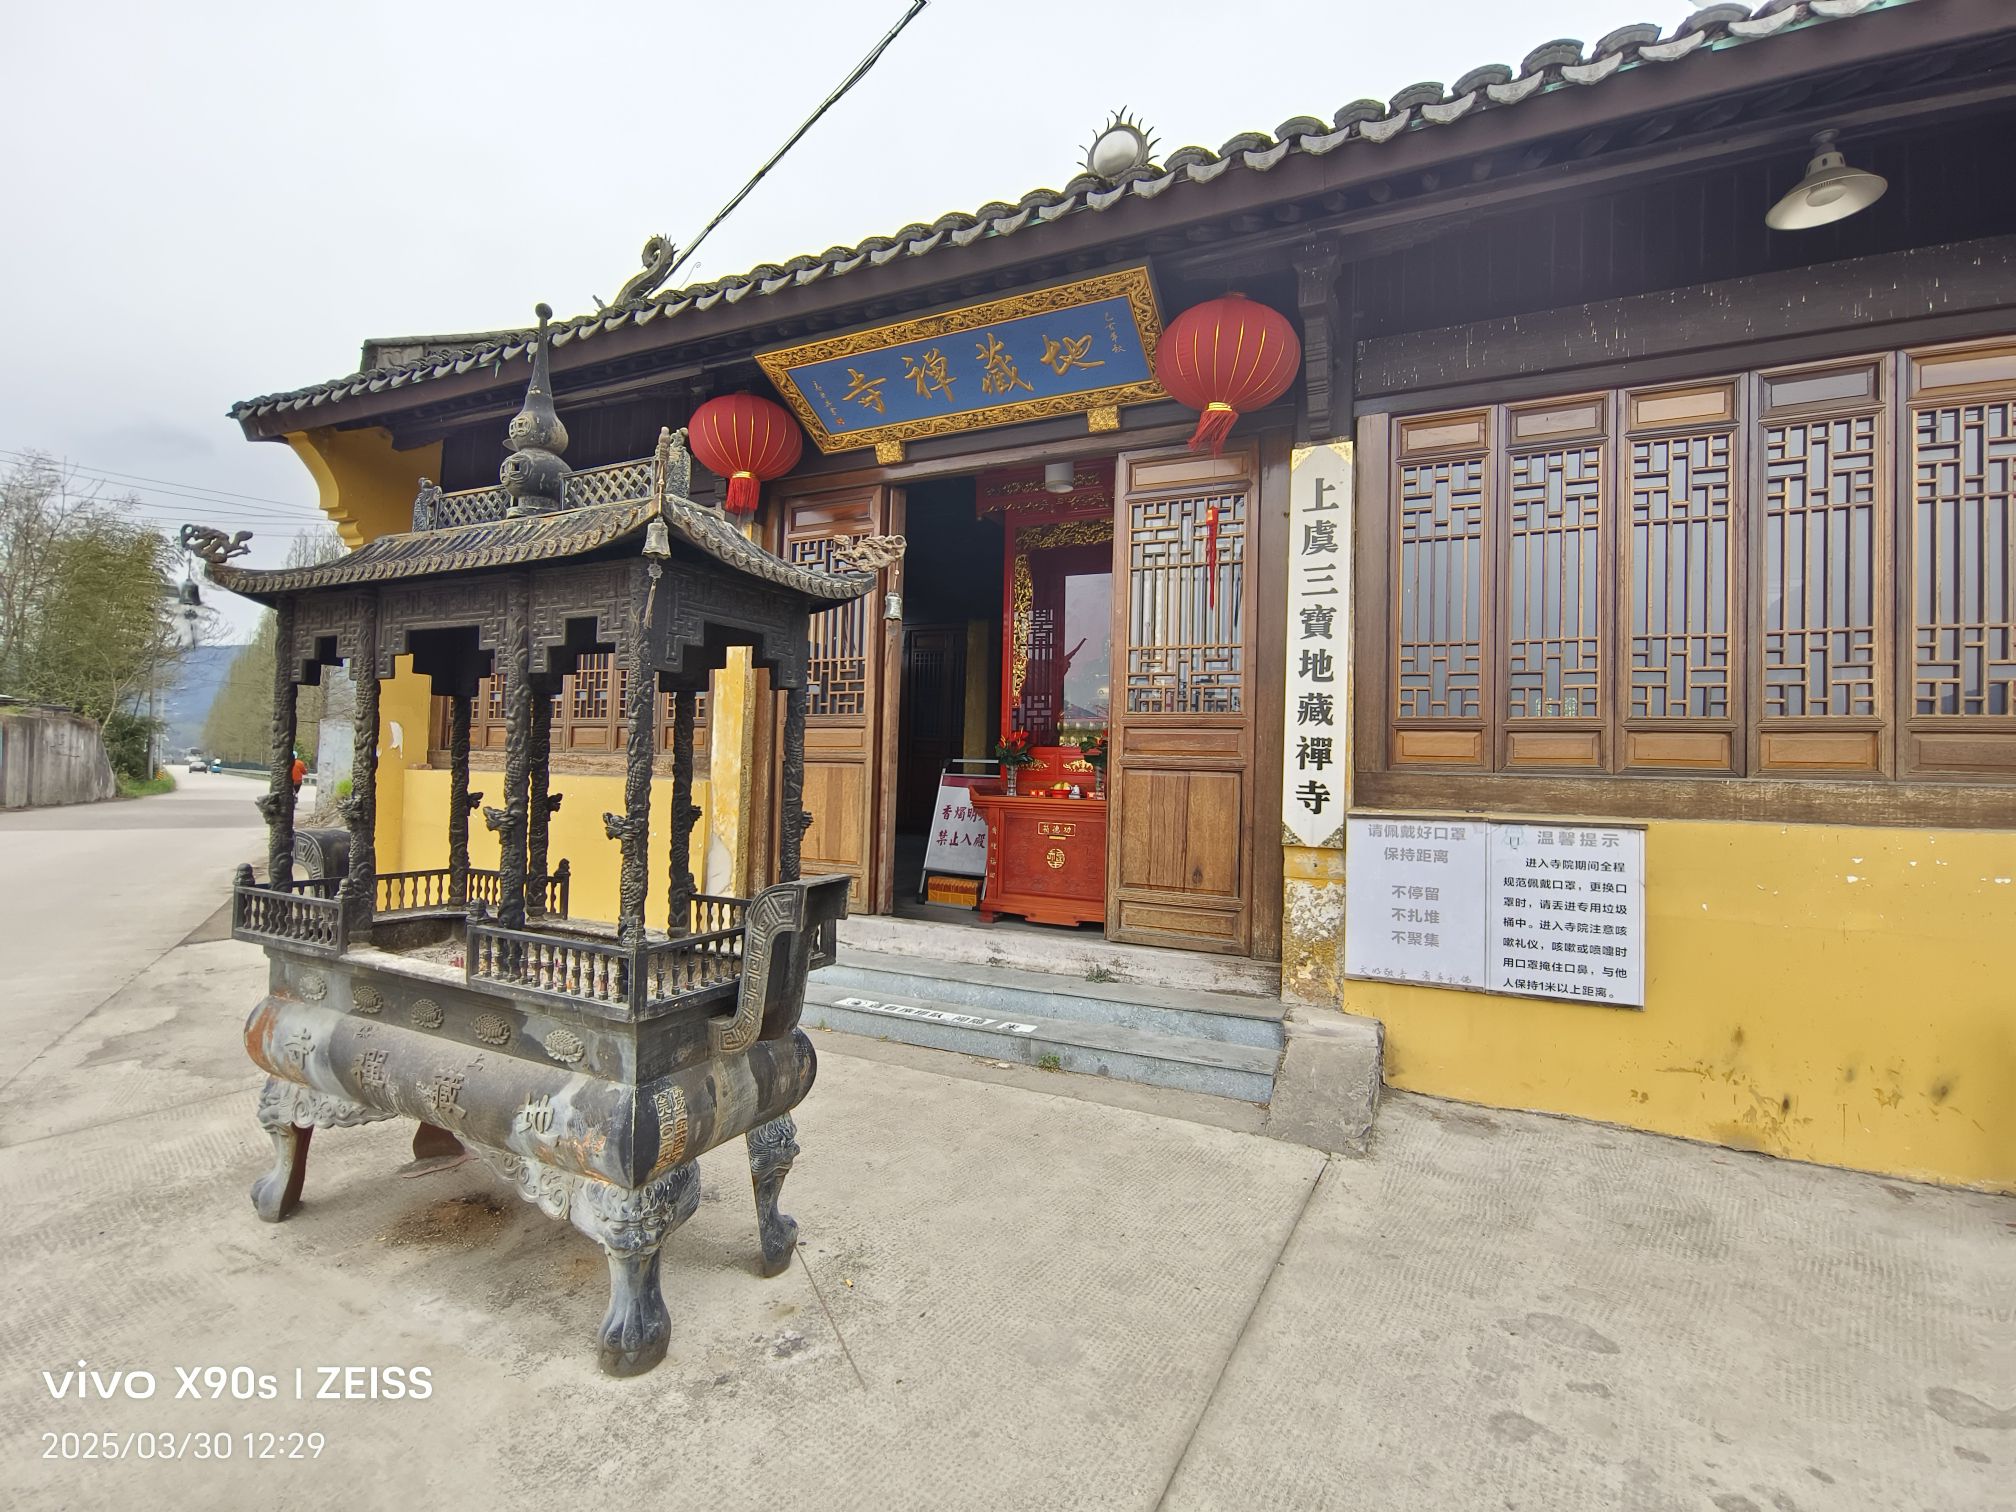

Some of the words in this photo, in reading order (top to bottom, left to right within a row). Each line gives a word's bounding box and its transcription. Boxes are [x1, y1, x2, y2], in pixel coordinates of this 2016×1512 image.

[1295, 477, 1339, 814] 上虞三寶地藏禪寺
[936, 829, 986, 849] 禁止入殿
[1368, 823, 1467, 841] 请佩戴好口罩
[1537, 830, 1620, 848] 温馨提示
[1384, 847, 1449, 864] 保持距离
[1525, 857, 1626, 873] 进入寺院期间全程
[1391, 885, 1440, 901] 不停留
[1503, 876, 1627, 894] 规范佩戴口罩，更换口
[1503, 896, 1628, 915] 罩时，请丢进专用垃圾
[1391, 907, 1440, 924] 不扎堆
[1503, 916, 1628, 936] 桶中。进入寺院注意咳
[1391, 930, 1440, 948] 不聚集
[1502, 937, 1628, 958] 嗽礼仪，咳嗽或喷嚏时
[1502, 957, 1628, 979] 用口罩掩住口鼻，与他
[1502, 977, 1615, 999] 人保持1米以上距离。
